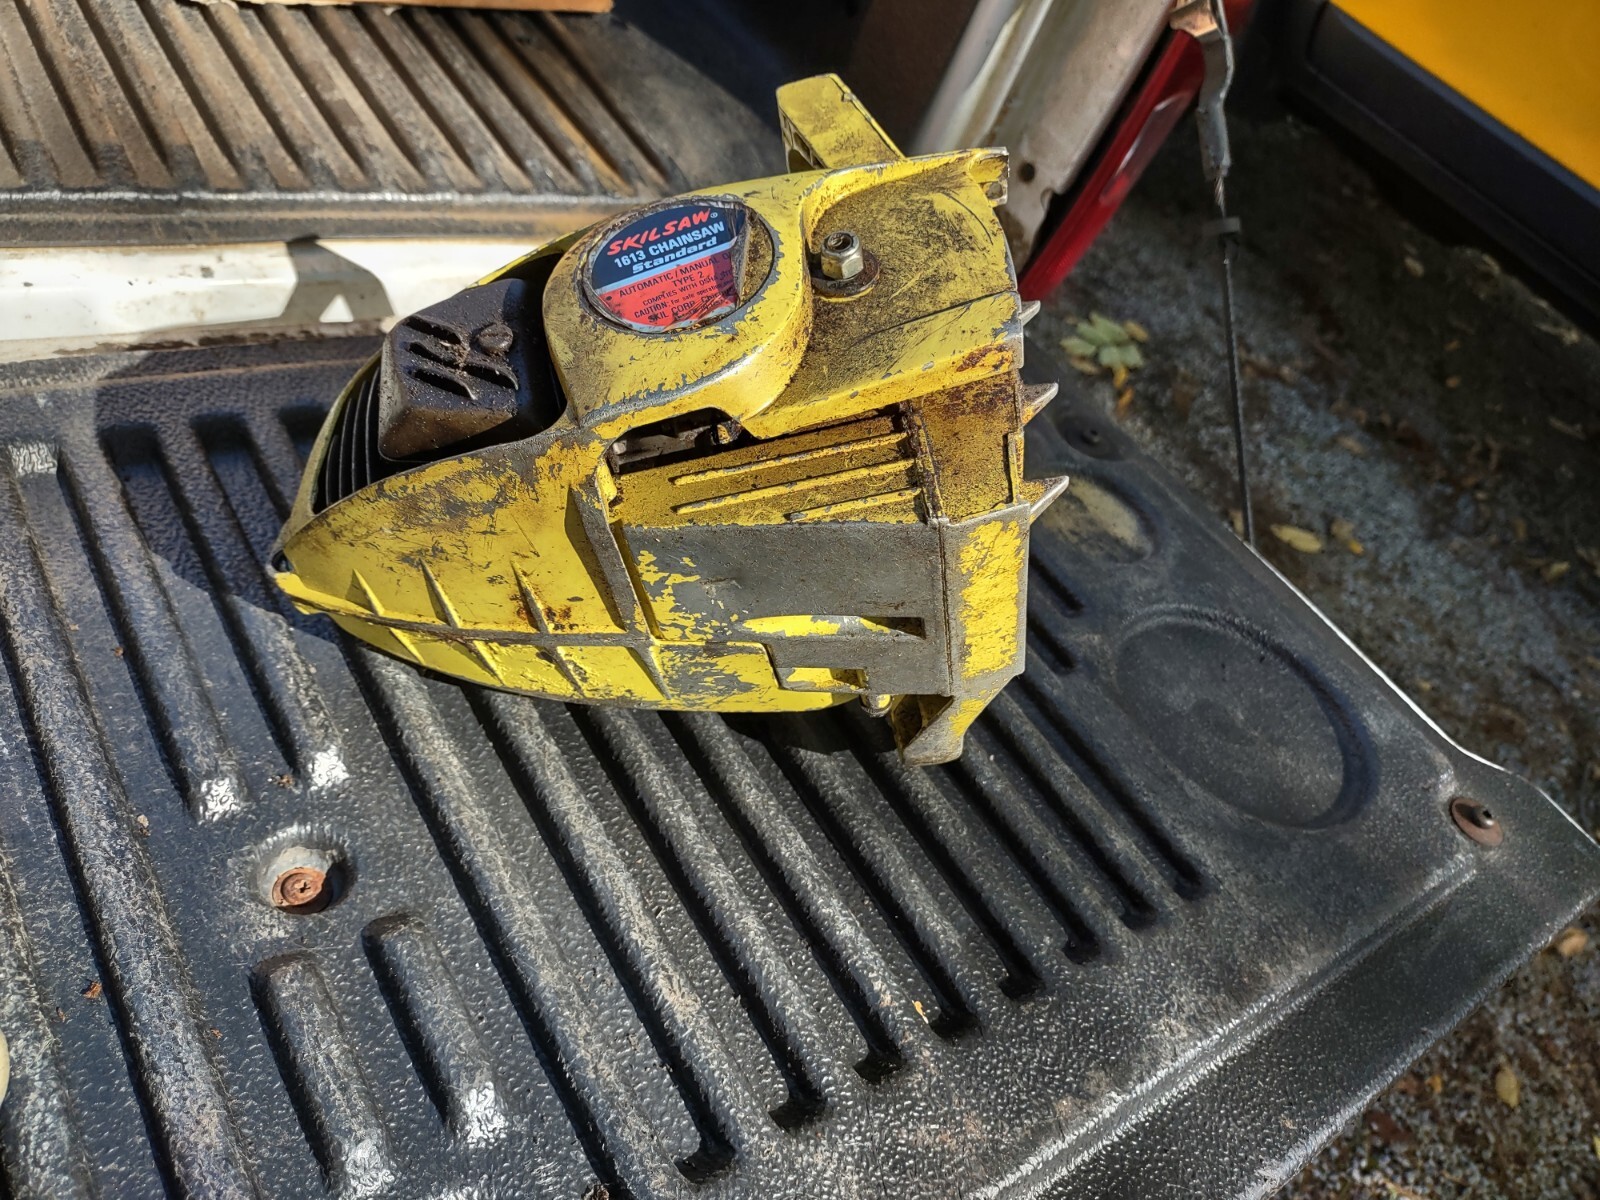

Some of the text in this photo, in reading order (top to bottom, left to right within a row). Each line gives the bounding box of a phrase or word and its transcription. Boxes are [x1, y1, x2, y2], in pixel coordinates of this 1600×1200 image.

[607, 208, 711, 256] SKILSAW
[614, 221, 725, 268] 1613 CHAINSAW
[632, 236, 717, 274] Standard
[619, 272, 674, 298] AUTOMATIC
[680, 256, 720, 276] MANUAL
[643, 289, 677, 306] COMPLIES
[679, 283, 698, 293] WITH
[672, 271, 705, 287] TYPE 2
[648, 312, 669, 322] SKIL
